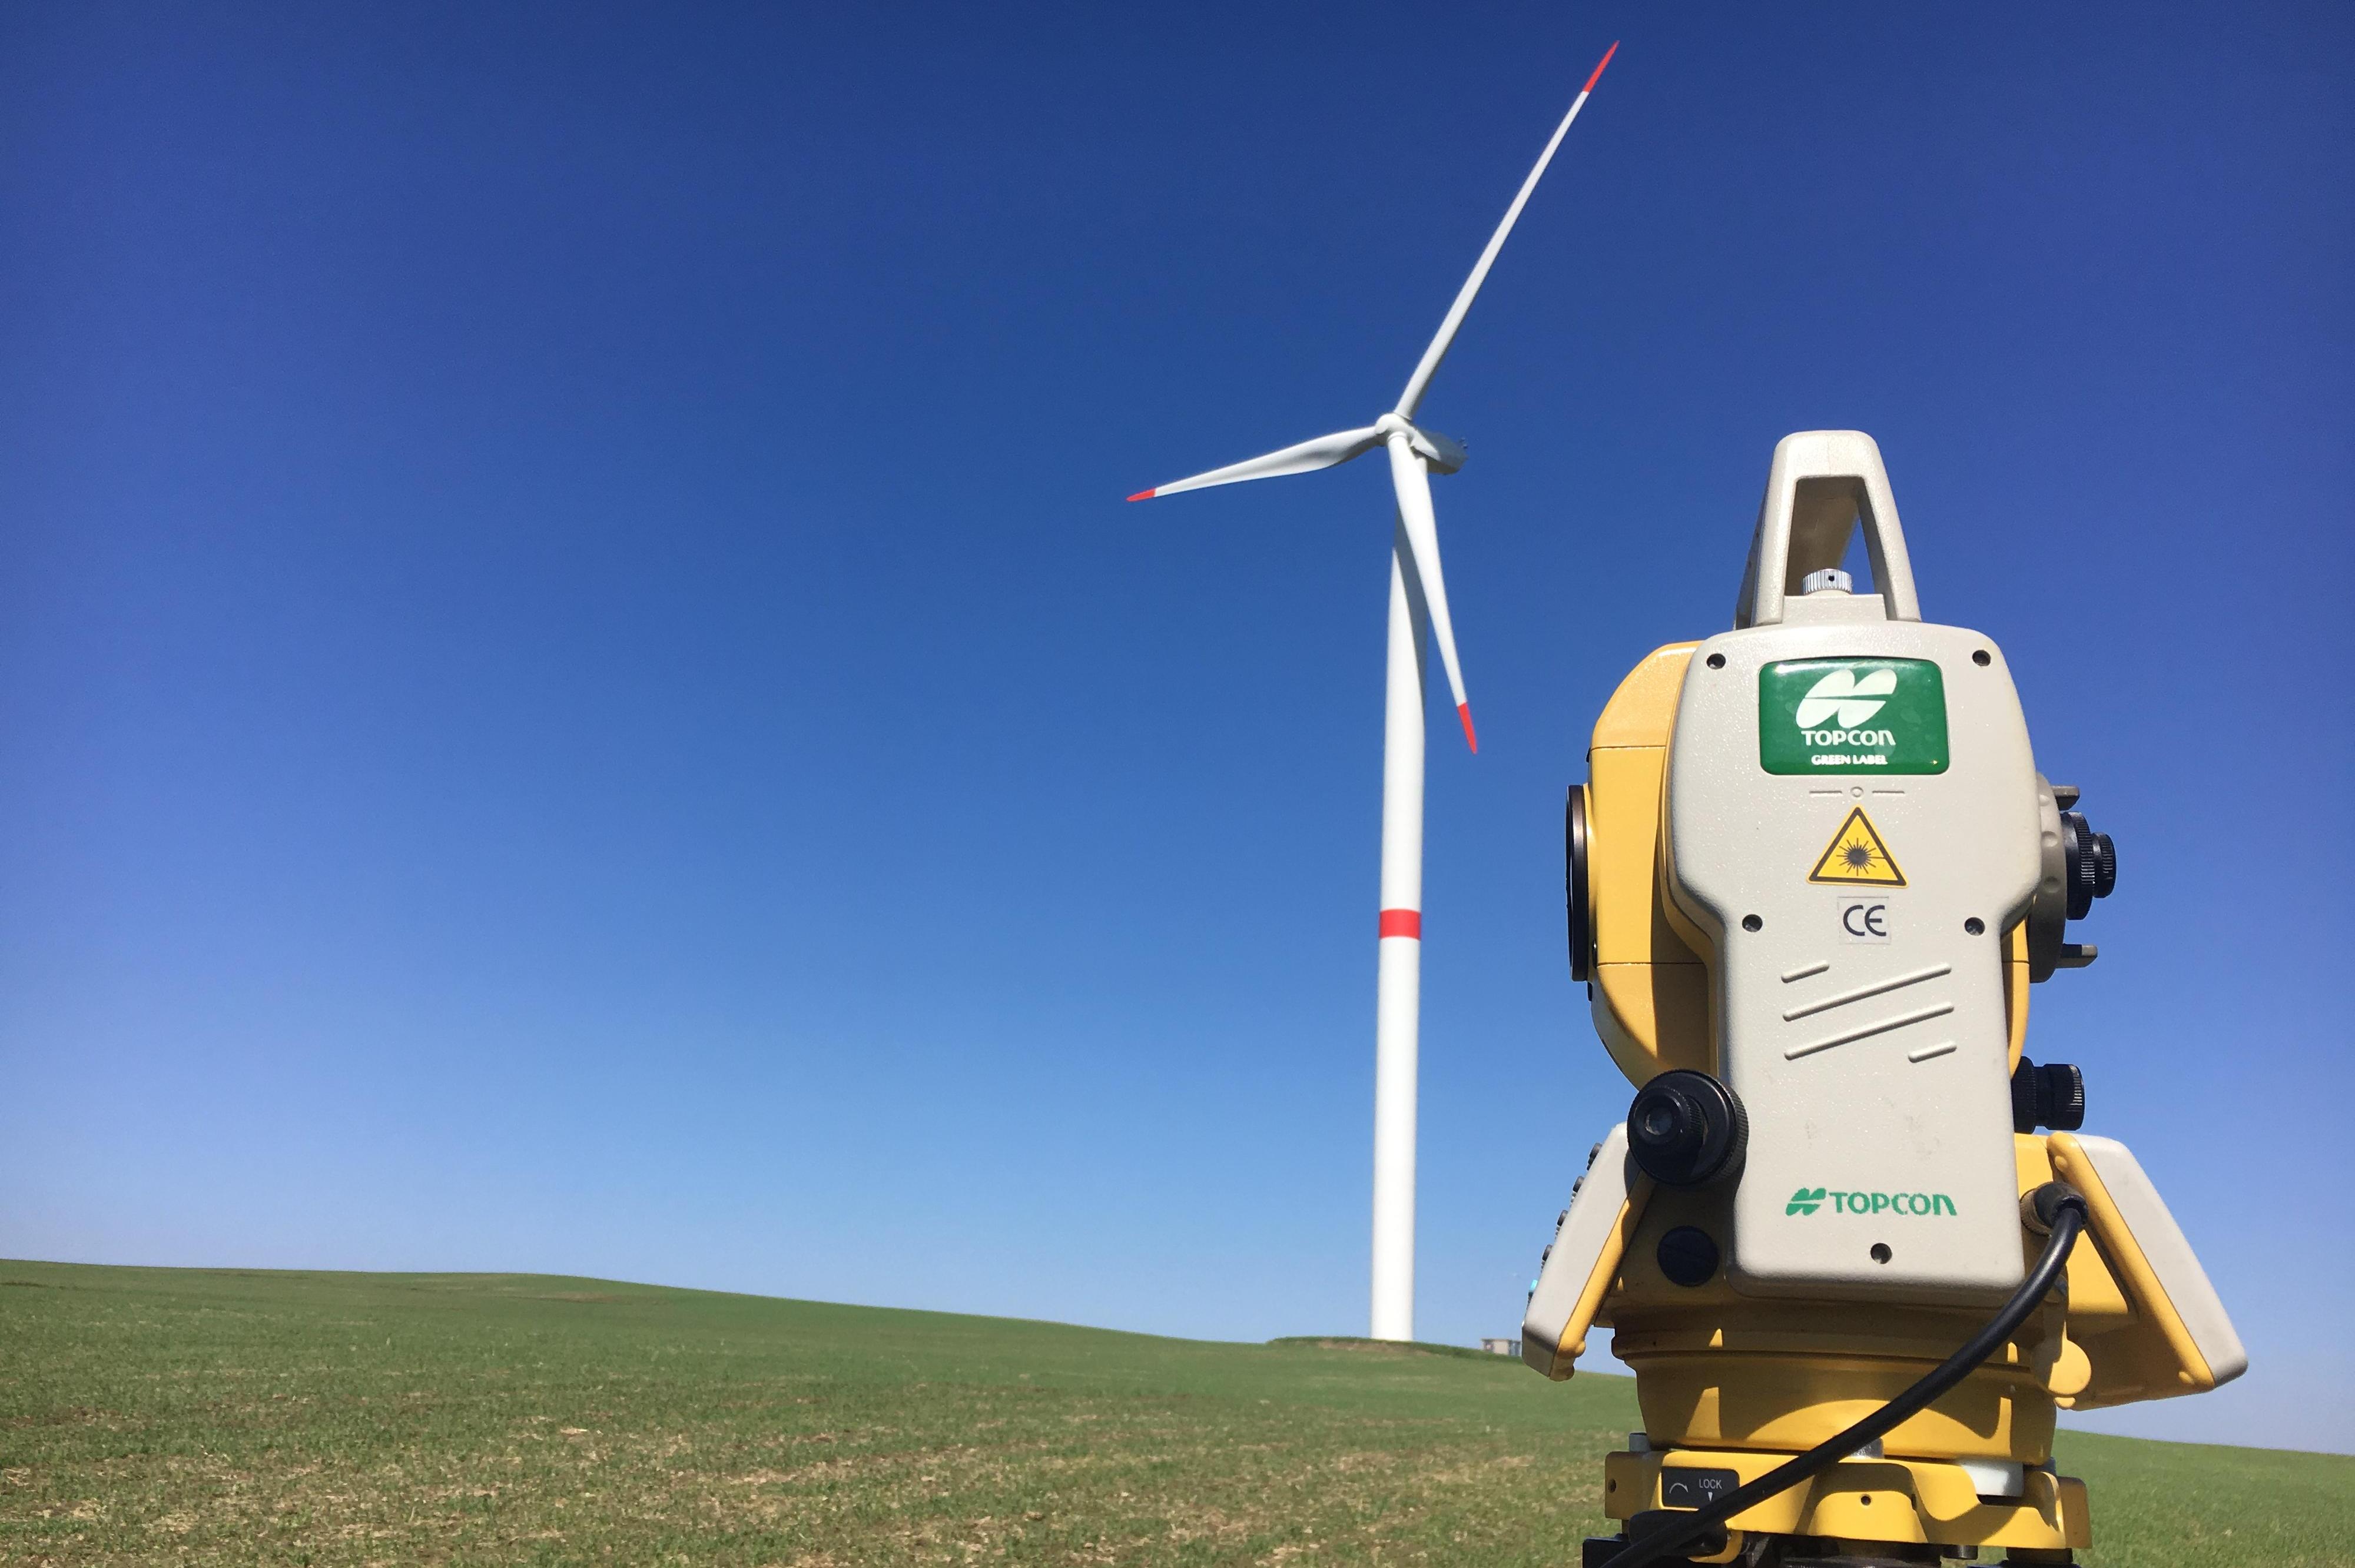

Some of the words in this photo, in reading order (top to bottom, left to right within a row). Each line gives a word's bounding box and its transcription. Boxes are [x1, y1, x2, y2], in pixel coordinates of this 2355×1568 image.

[1801, 730, 1896, 746] TOPCON
[1811, 755, 1850, 765] GREEN
[1853, 755, 1888, 765] LABEL
[1843, 905, 1886, 936] CE
[1829, 1191, 1958, 1216] TOPCON
[1699, 1479, 1722, 1490] LOCK
